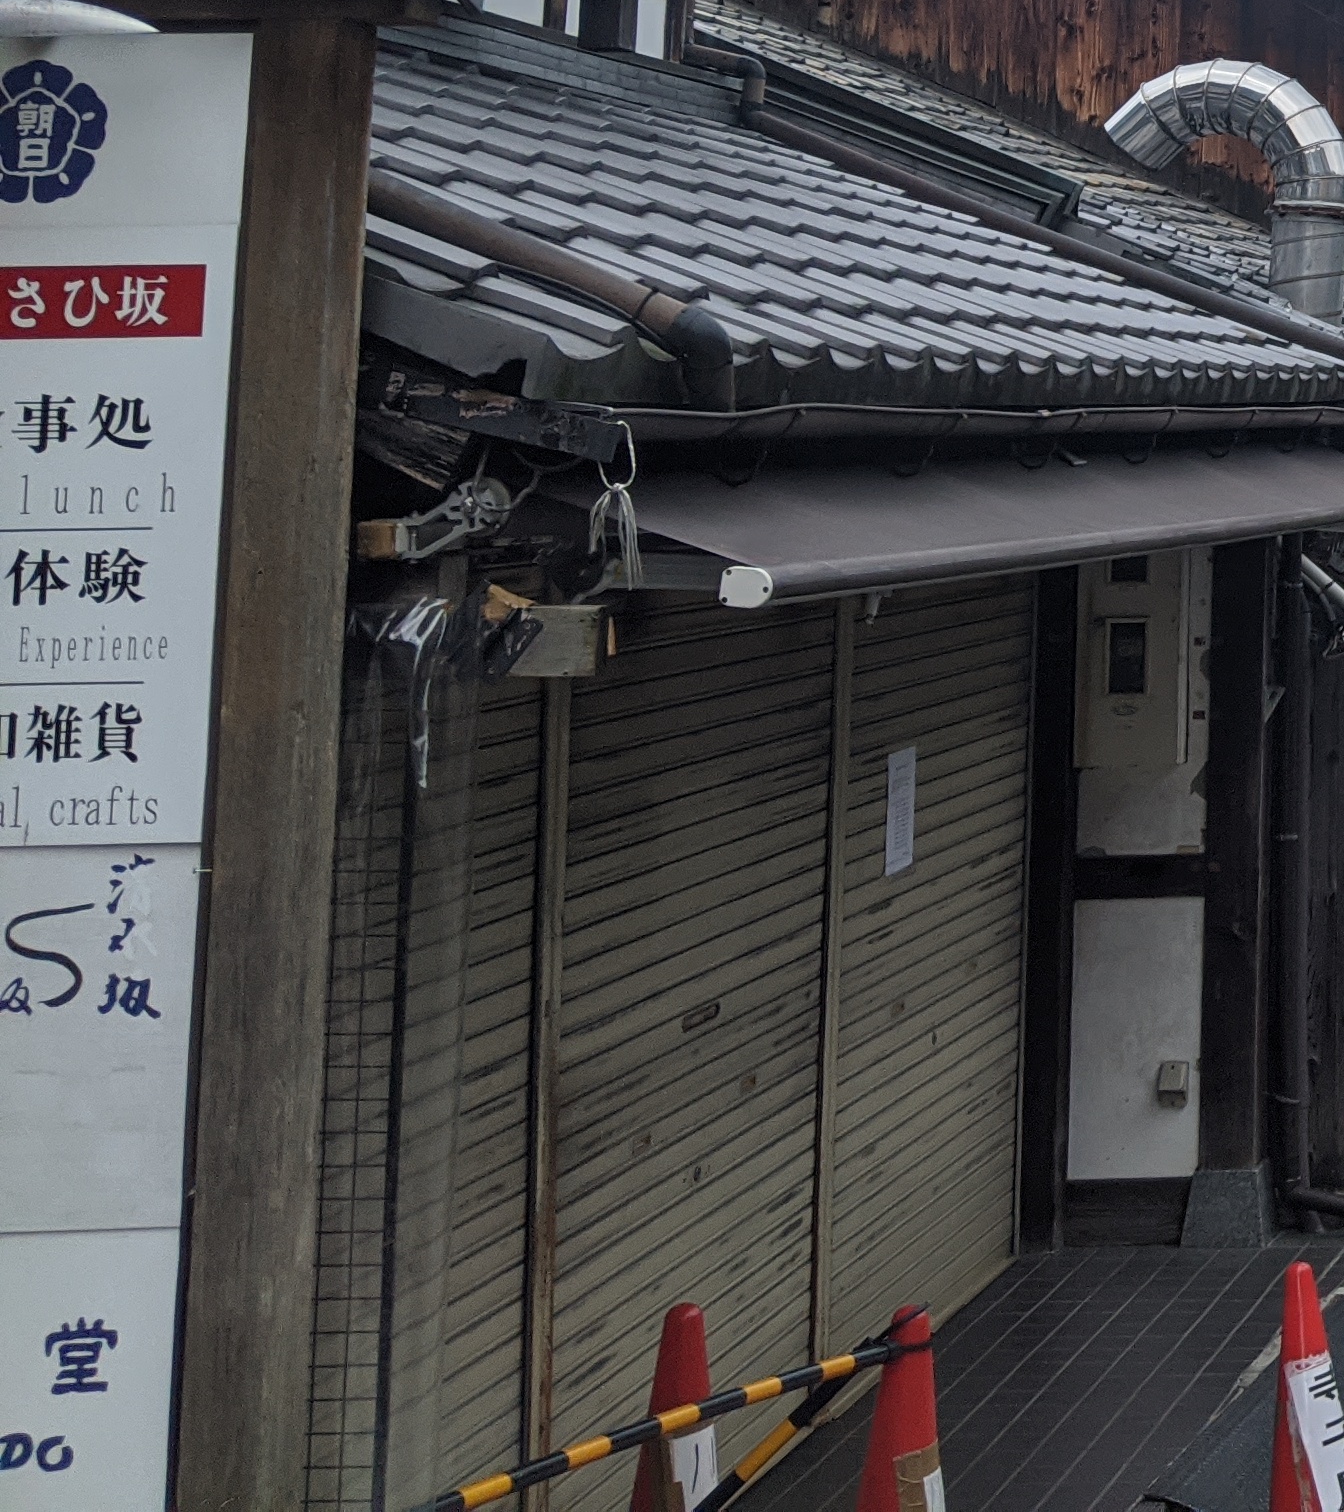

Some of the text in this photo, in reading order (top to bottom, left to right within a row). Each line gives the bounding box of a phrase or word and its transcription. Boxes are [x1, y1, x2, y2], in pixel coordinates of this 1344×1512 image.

[17, 100, 56, 169] 朝日
[0, 393, 153, 454] 事処
[19, 472, 176, 515] lunch
[4, 548, 148, 606] 体験
[19, 626, 168, 669] Experience
[0, 701, 143, 764] 雑貨
[50, 785, 159, 828] crafts
[45, 1317, 118, 1395] 堂
